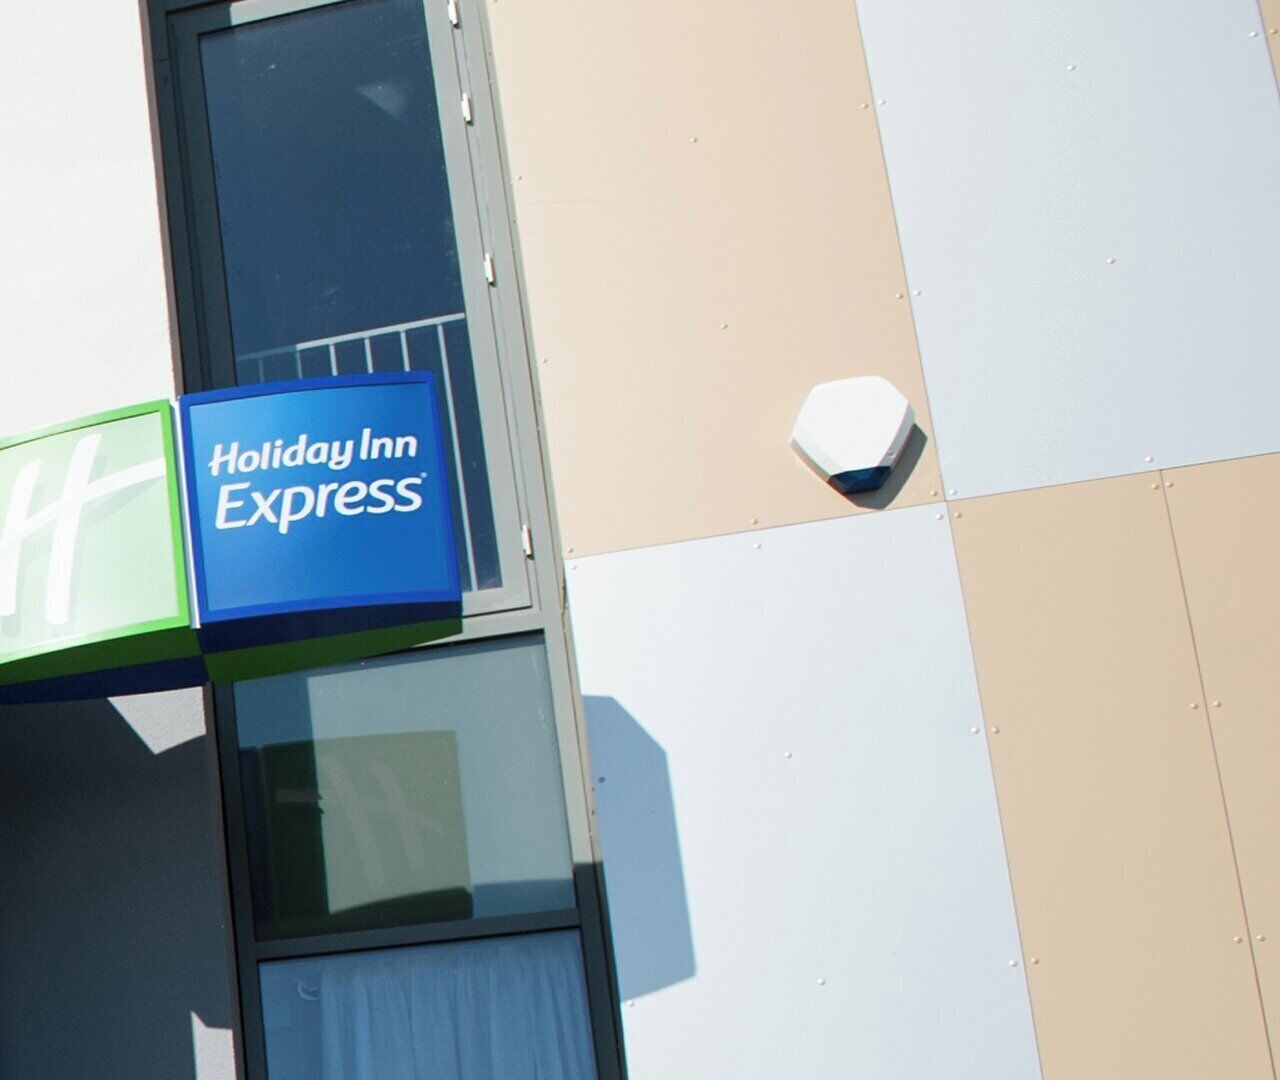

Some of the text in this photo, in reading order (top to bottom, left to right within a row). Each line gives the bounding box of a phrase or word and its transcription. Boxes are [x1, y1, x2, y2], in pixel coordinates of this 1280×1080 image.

[208, 428, 417, 477] Holiday Inn
[214, 476, 423, 535] Express
